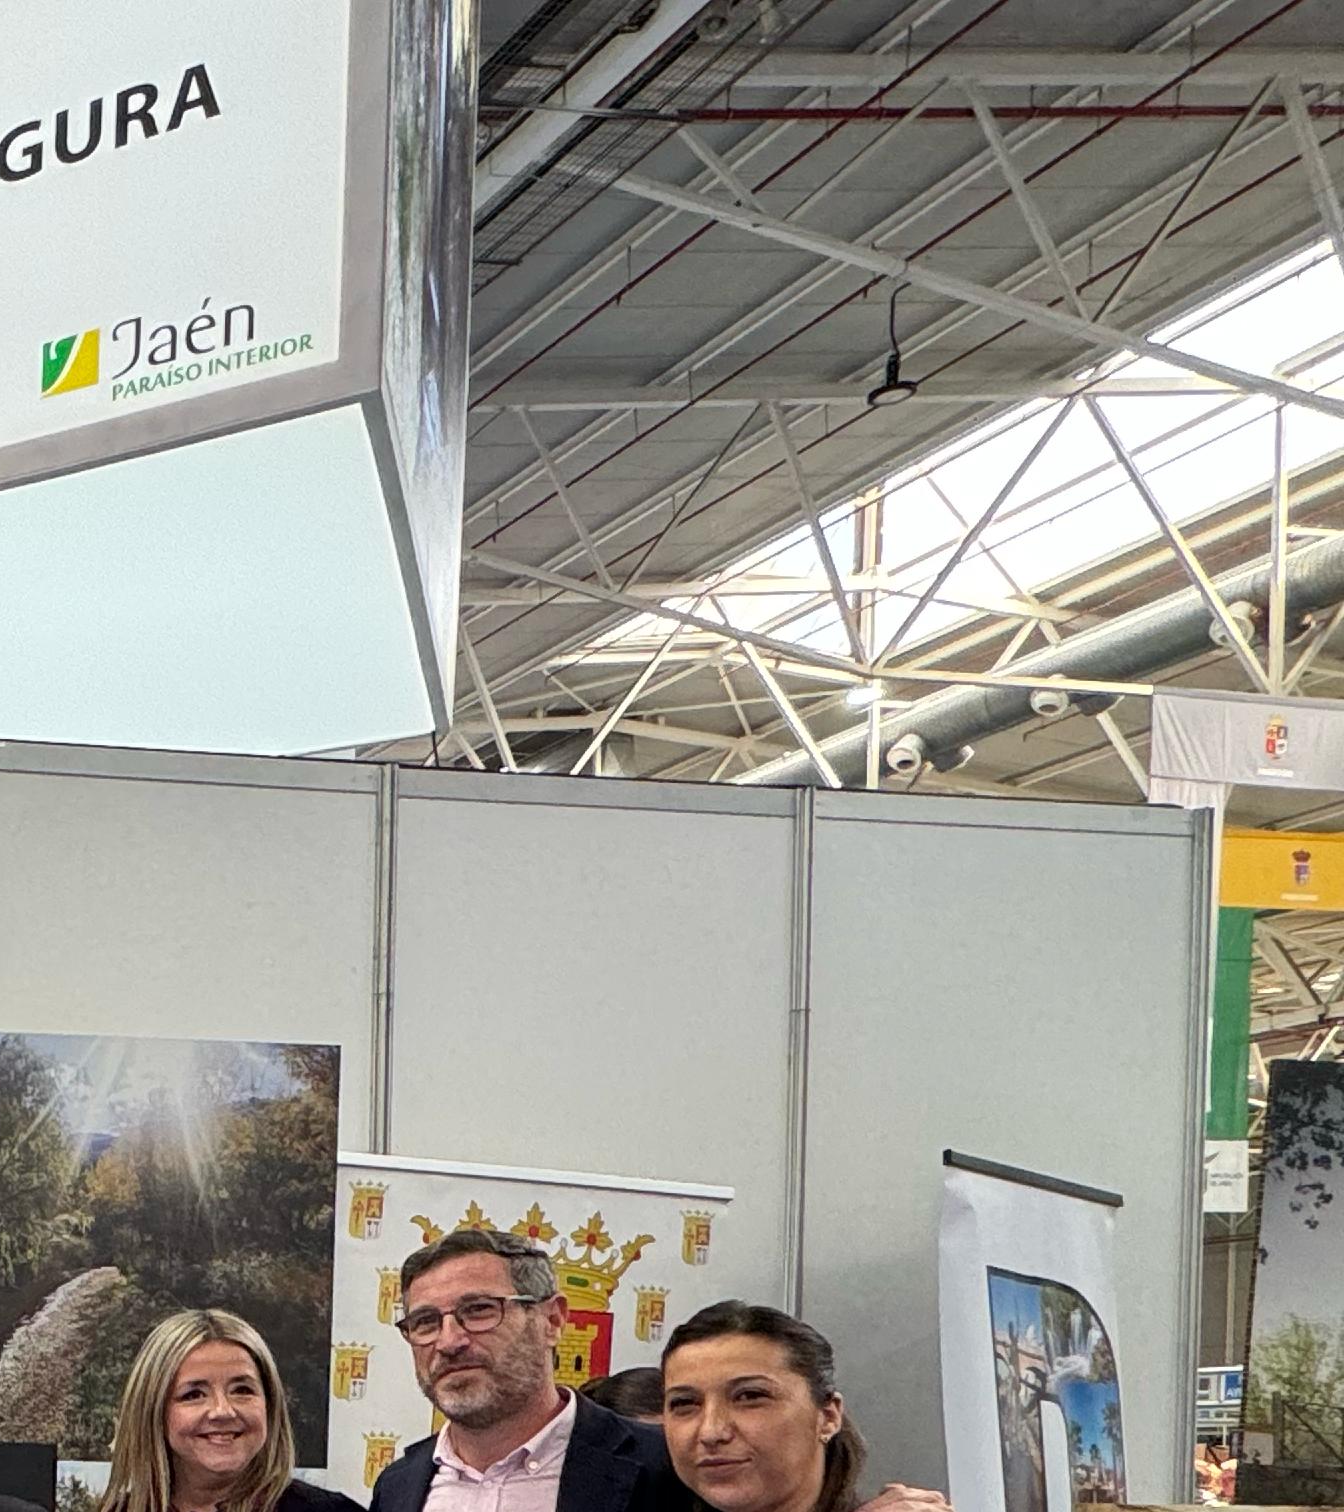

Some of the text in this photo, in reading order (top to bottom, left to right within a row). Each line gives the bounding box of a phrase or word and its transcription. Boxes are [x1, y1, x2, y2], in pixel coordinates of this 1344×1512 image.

[111, 297, 255, 381] Jaén
[112, 333, 314, 402] PARAÍSO INTERIOR
